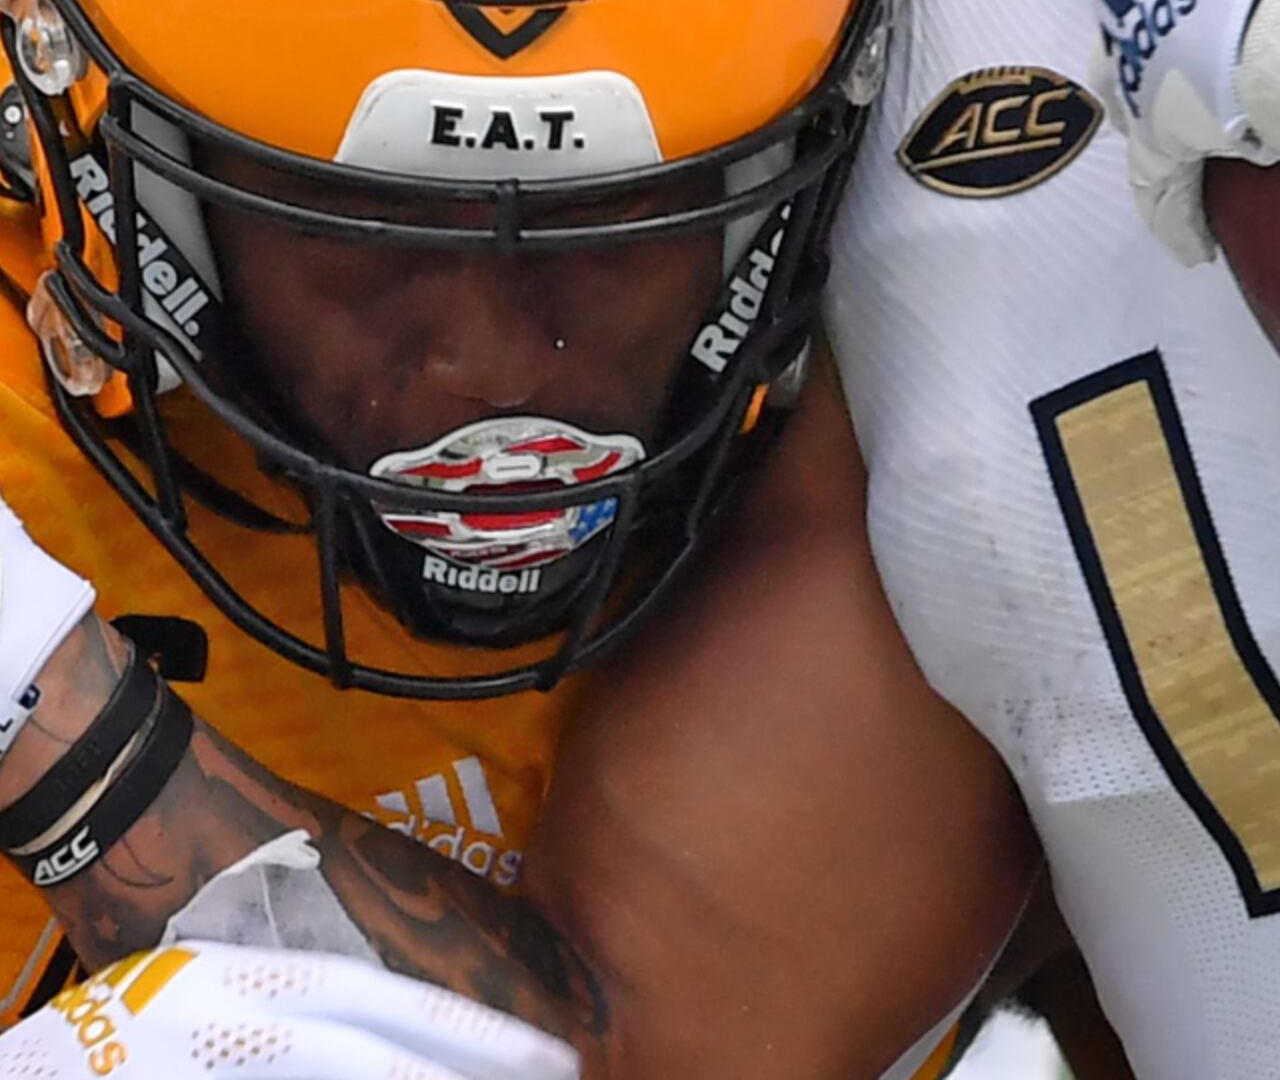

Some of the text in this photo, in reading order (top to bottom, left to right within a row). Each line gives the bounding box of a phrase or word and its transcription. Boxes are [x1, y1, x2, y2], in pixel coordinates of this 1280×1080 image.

[430, 104, 585, 151] E.A.T.
[930, 87, 1072, 155] ACC
[422, 554, 541, 593] Riddell
[34, 825, 100, 877] ACC
